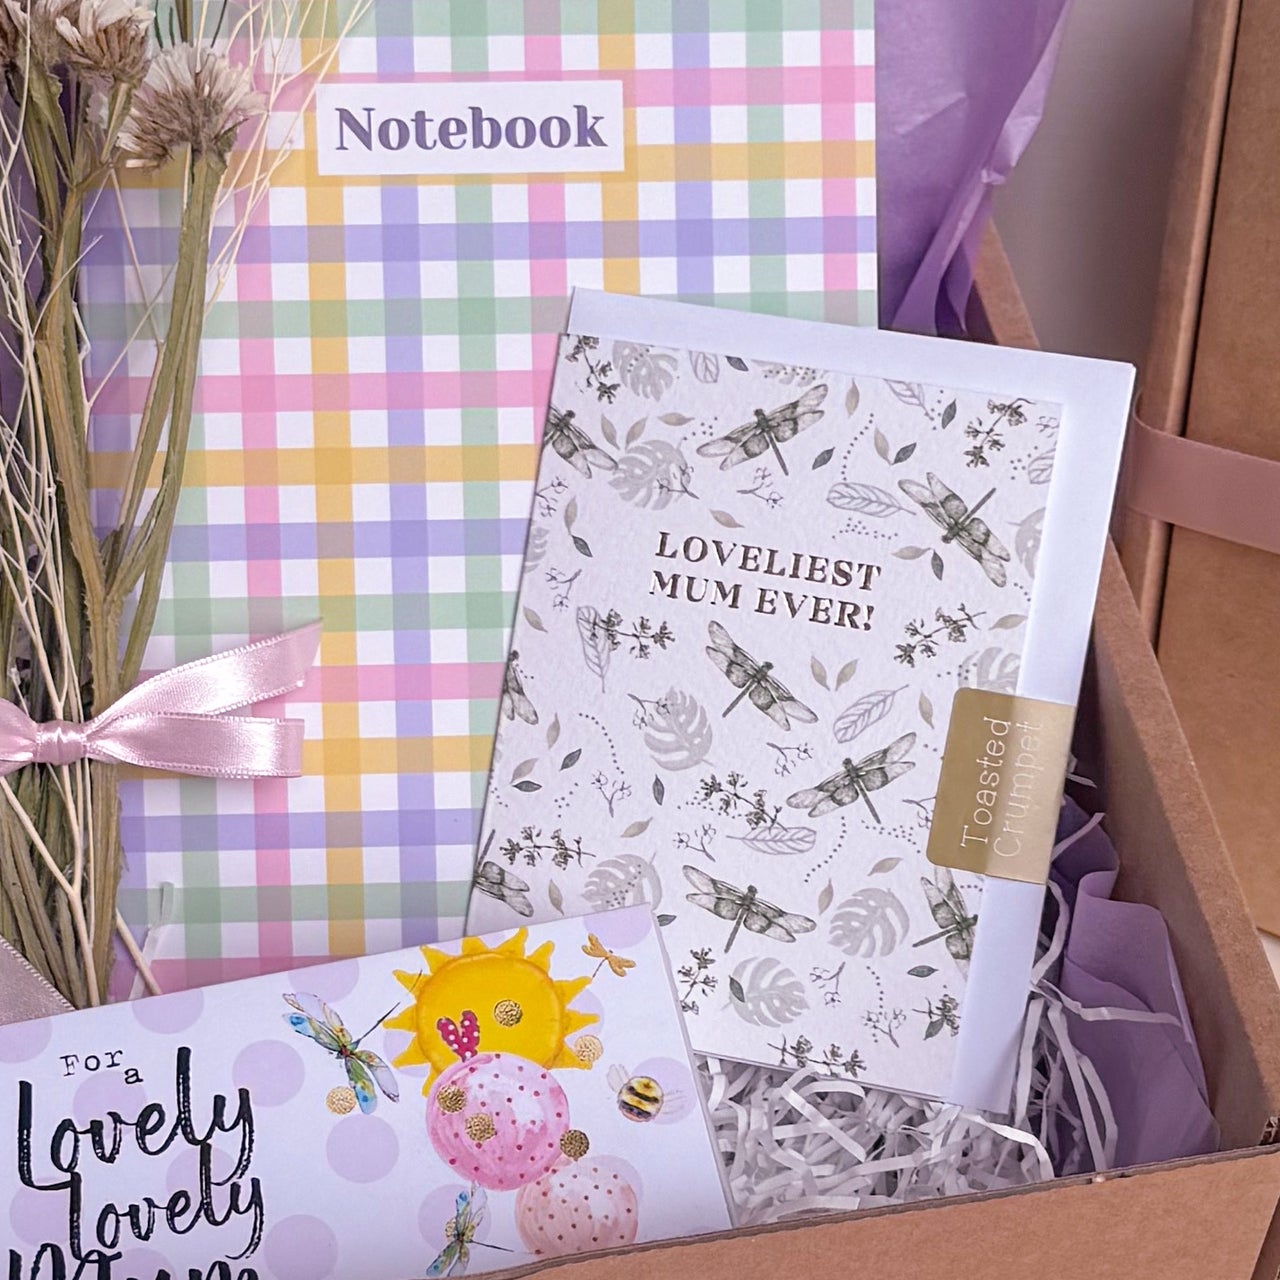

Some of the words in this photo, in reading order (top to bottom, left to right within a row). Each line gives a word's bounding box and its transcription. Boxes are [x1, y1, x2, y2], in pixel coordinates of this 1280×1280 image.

[336, 105, 607, 151] Notebook
[655, 531, 882, 592] LOVELIEST
[650, 570, 743, 610] MUM
[753, 587, 875, 632] EVER!
[961, 715, 1010, 849] Toasted
[993, 719, 1043, 858] Crumpet
[61, 1049, 124, 1077] For
[124, 1067, 144, 1085] a
[18, 1046, 254, 1190] Lovely
